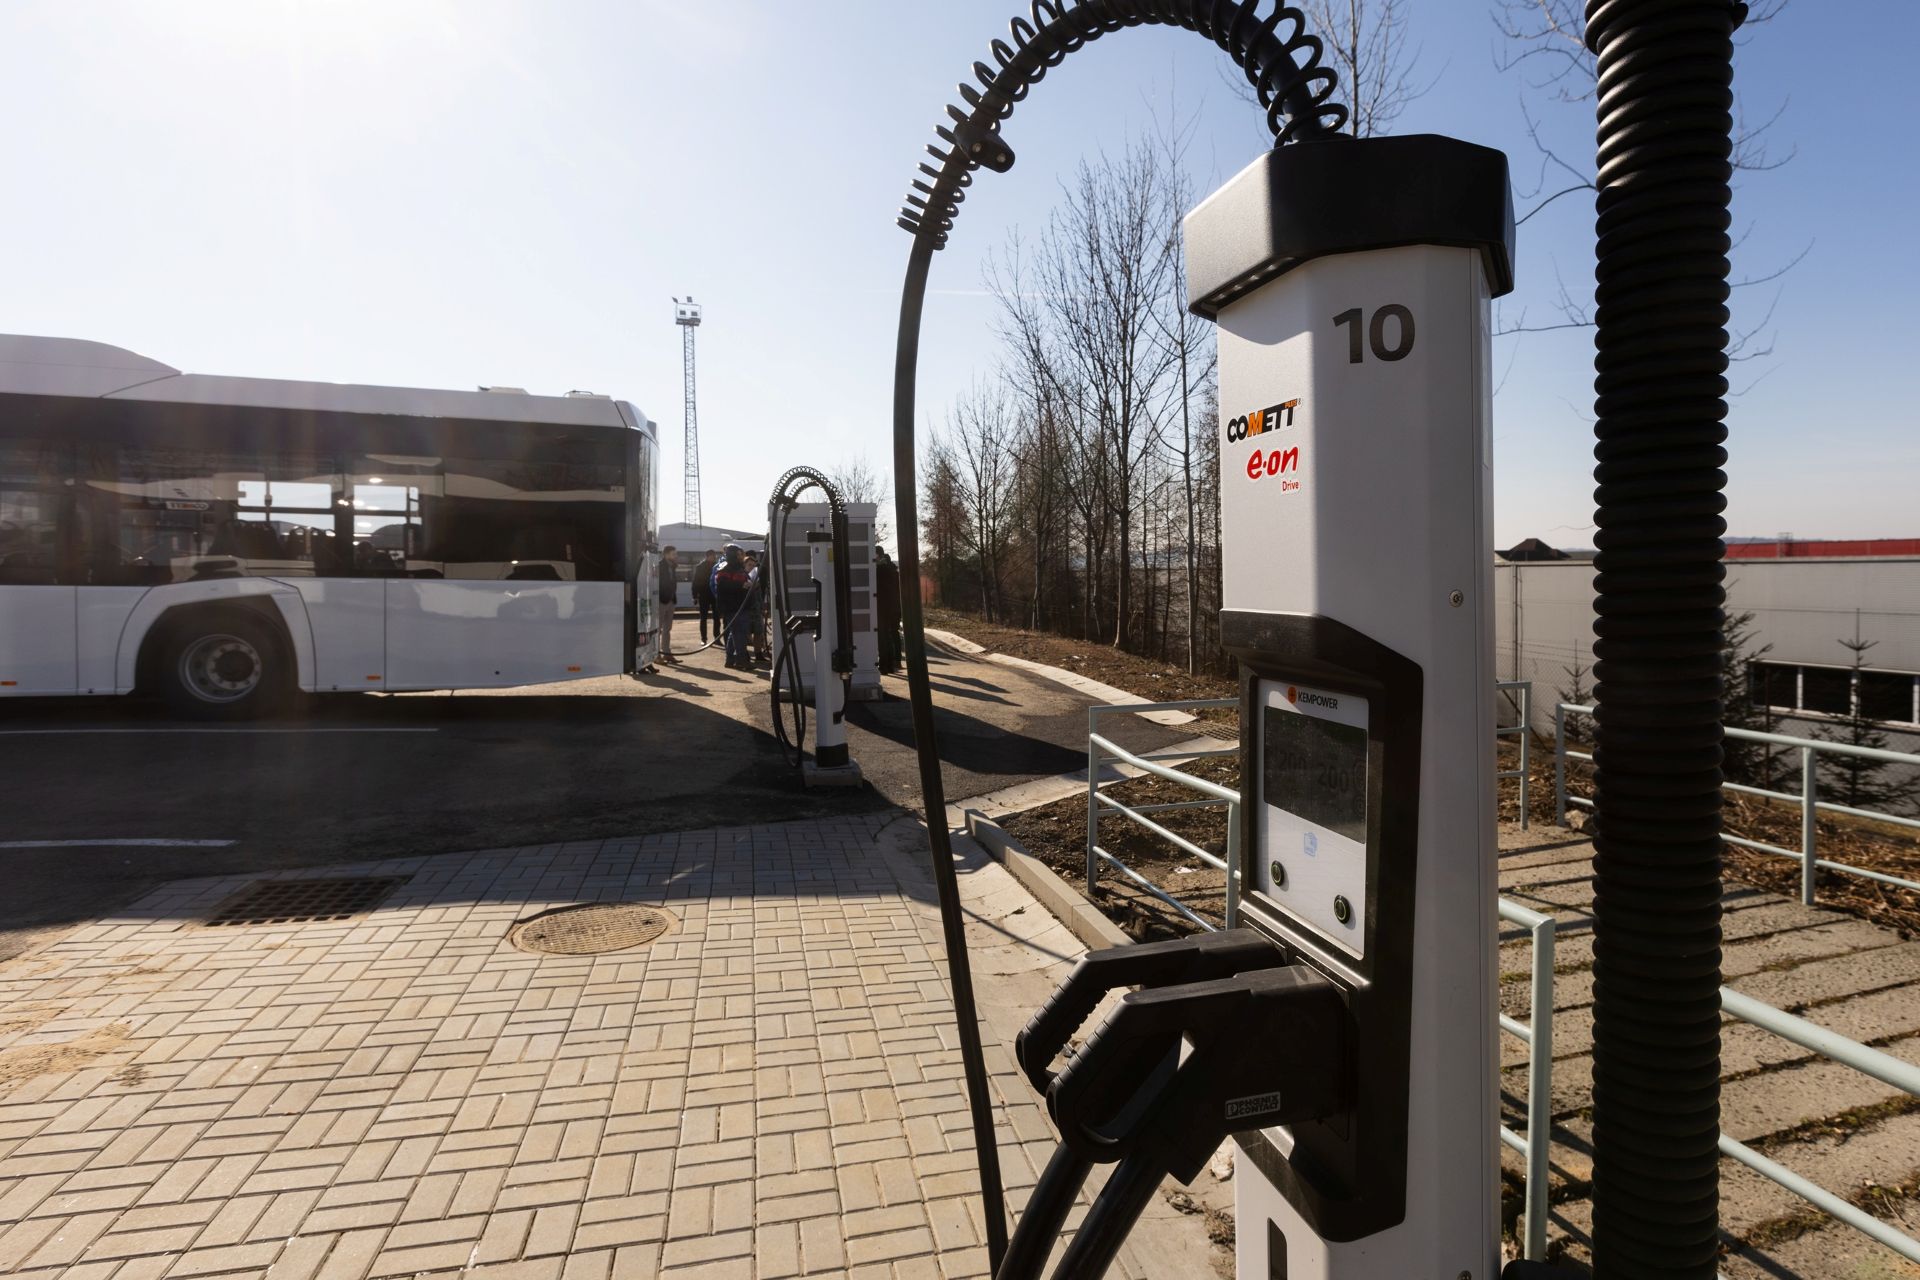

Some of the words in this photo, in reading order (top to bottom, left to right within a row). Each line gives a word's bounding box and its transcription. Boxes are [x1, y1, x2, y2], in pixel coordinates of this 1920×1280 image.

[1332, 303, 1416, 364] 10
[1227, 401, 1297, 443] COMETT
[1282, 480, 1299, 491] Drive
[1298, 690, 1338, 709] KEMPOWER
[1240, 1101, 1278, 1115] CONTACT
